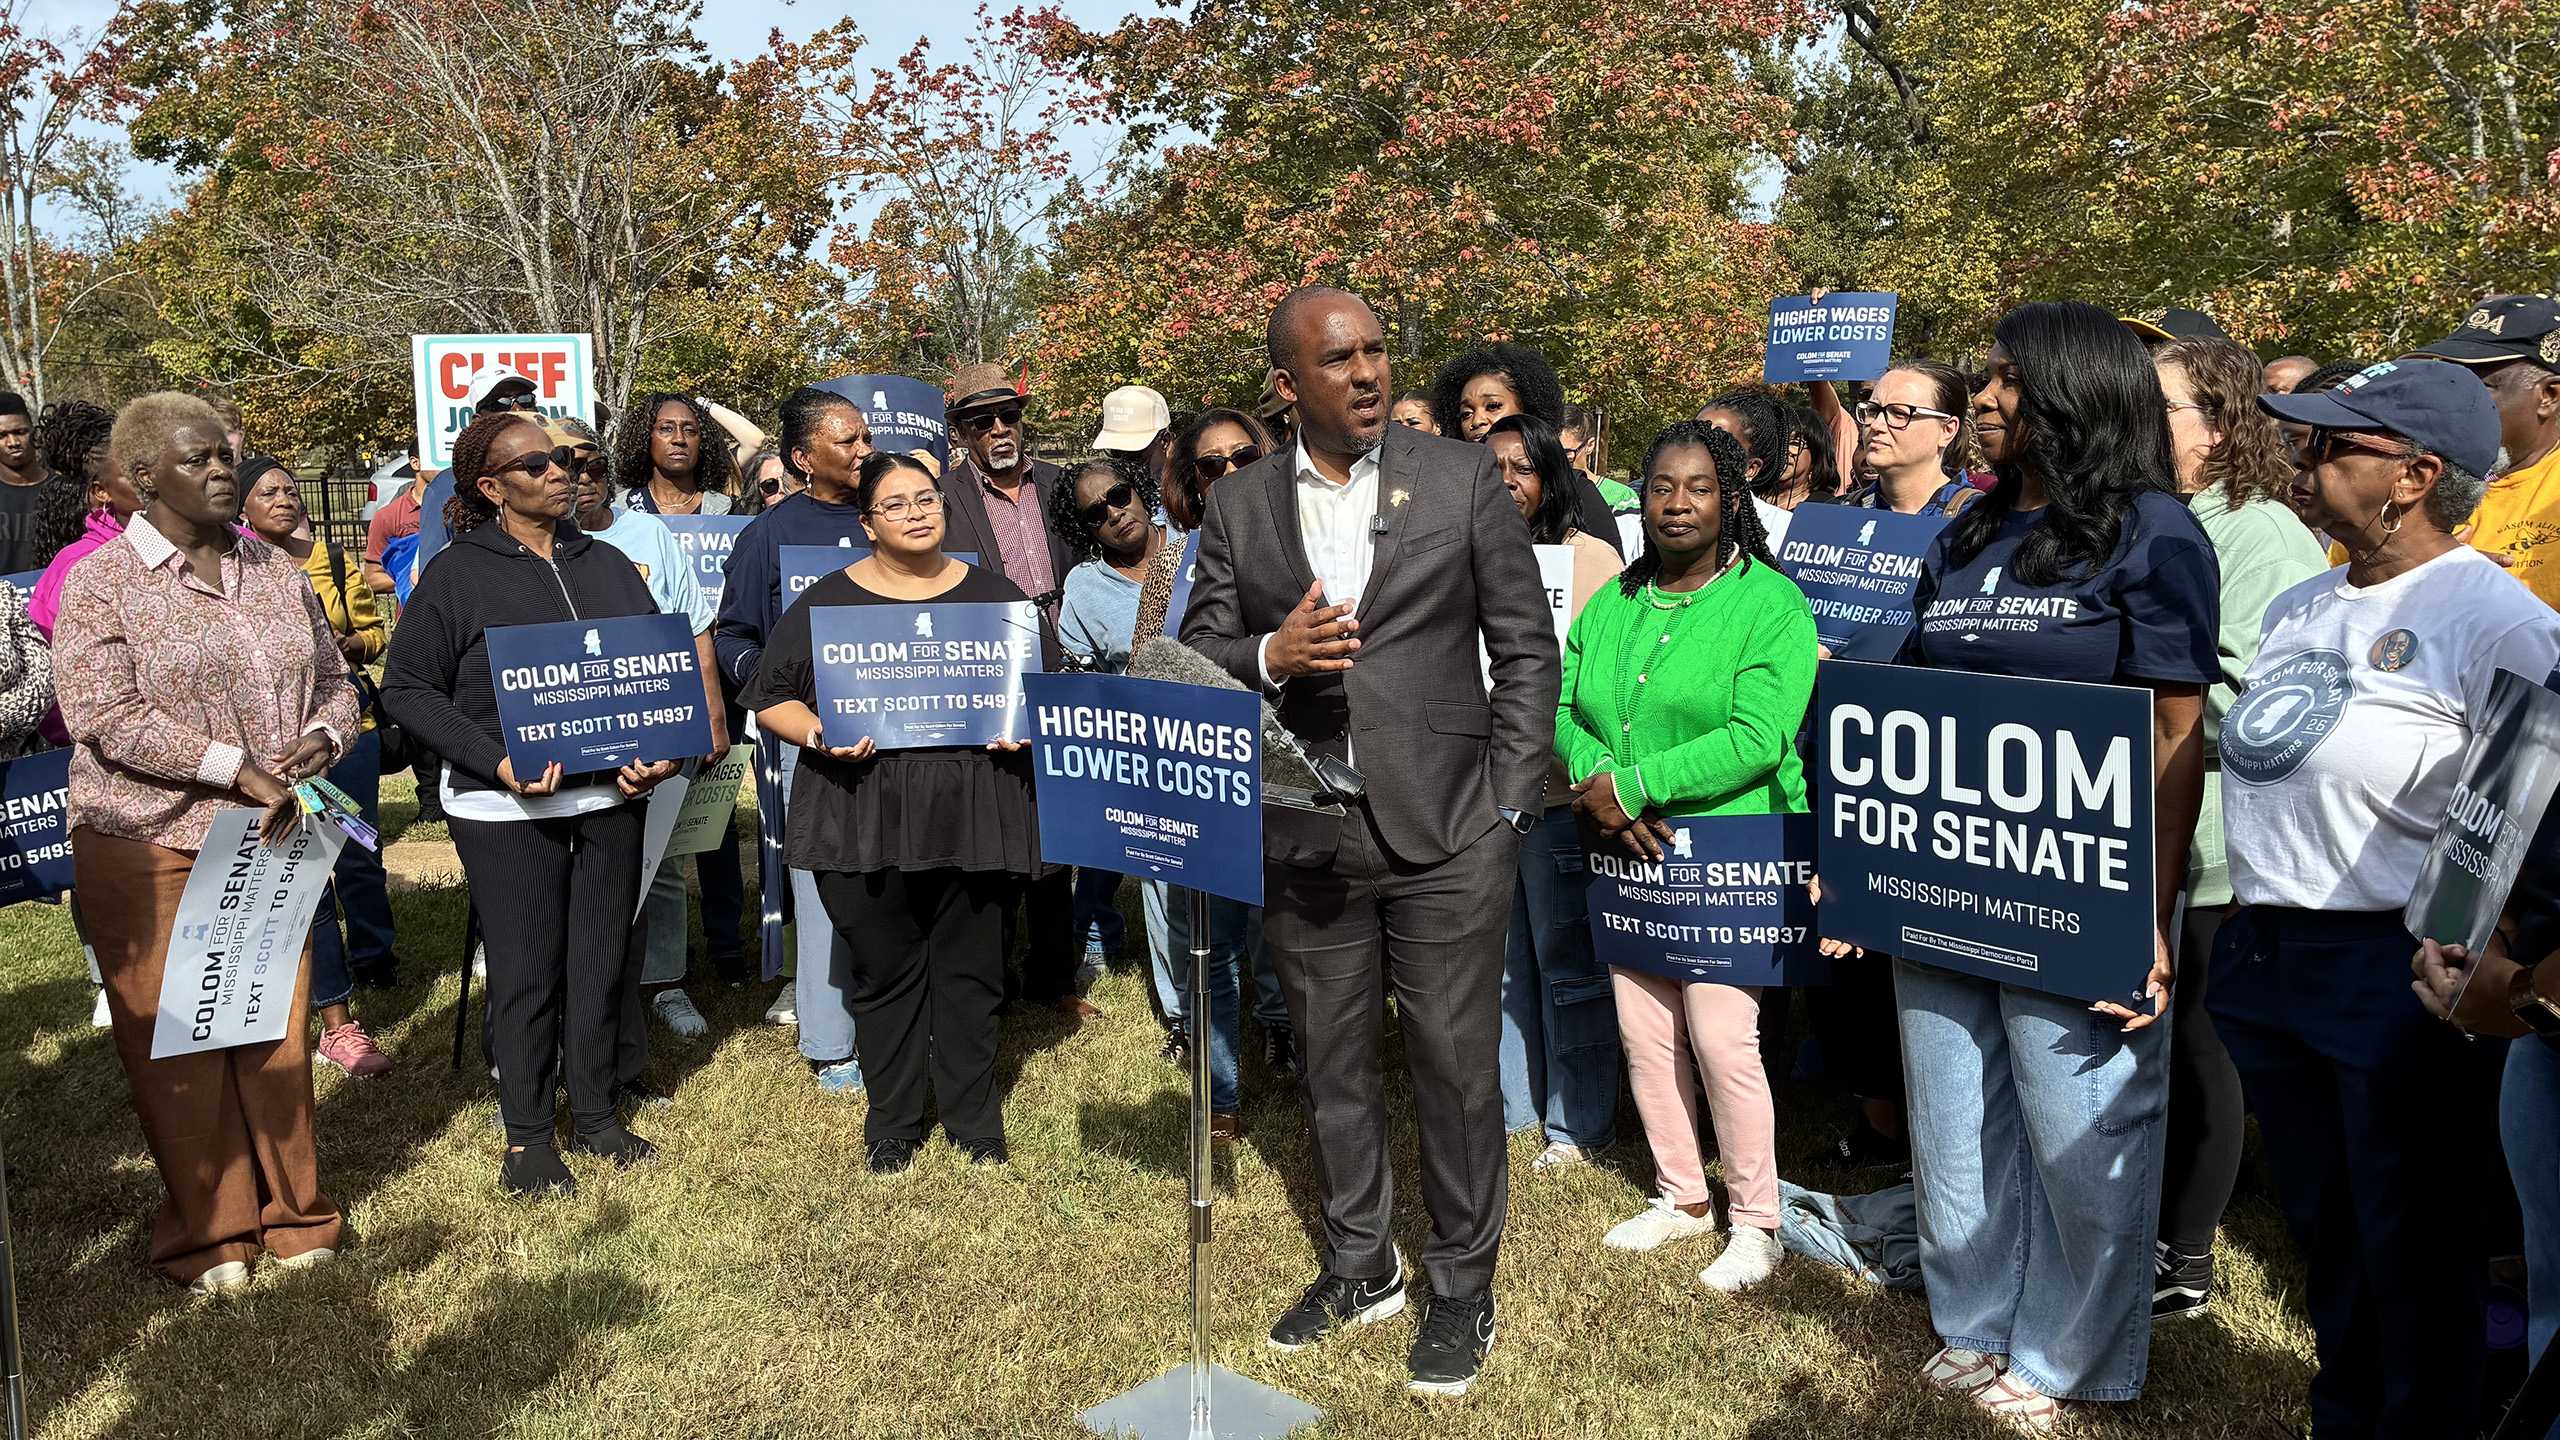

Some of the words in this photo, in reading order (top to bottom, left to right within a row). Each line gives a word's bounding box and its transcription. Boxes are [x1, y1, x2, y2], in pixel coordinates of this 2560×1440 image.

[1774, 307, 1827, 327] HIGHER
[1831, 307, 1890, 322] WAGES
[1772, 326, 1825, 345] LOWER
[1829, 325, 1887, 341] COSTS
[1826, 351, 1851, 359] SENATE
[872, 413, 892, 422] FOR
[896, 411, 945, 436] SENATE
[895, 426, 934, 441] MATTERS
[1783, 541, 1844, 567] COLOM
[1844, 552, 1867, 567] FOR
[1868, 552, 1923, 579] SENA
[1796, 568, 1856, 588] MISSISSIPPI
[1858, 577, 1908, 595] MATTERS
[1882, 609, 1911, 626] 3RD
[1969, 600, 1993, 612] FOR
[1996, 596, 2078, 619] SENATE
[1923, 618, 1980, 633] MISSISSIPPI
[1981, 619, 2039, 632] MATTERS
[823, 642, 908, 664] COLOM
[913, 645, 940, 658] FOR
[944, 639, 1033, 661] SENATE
[501, 663, 580, 691] COLOM
[583, 664, 610, 679] FOR
[613, 651, 694, 679] SENATE
[856, 665, 940, 681] MISSISSIPPI
[944, 664, 1004, 678] MATTERS
[2297, 661, 2327, 675] FOR
[533, 684, 611, 706] MISSISSIPPI
[614, 678, 670, 697] MATTERS
[833, 697, 879, 714] TEXT
[884, 695, 941, 712] SCOTT
[943, 694, 967, 709] TO
[972, 692, 1026, 709] 5497
[517, 723, 556, 743] TEXT
[561, 715, 613, 737] SCOTT
[616, 712, 638, 730] TO
[642, 705, 694, 726] 54937
[1038, 705, 1147, 747] HIGHER
[1152, 716, 1252, 763] WAGES
[2306, 718, 2328, 732] 26
[1829, 703, 2131, 829] COLOM
[2263, 738, 2303, 771] MATTERS
[1044, 744, 1150, 788] LOWER
[1156, 757, 1251, 807] COSTS
[0, 787, 69, 822] ENAT
[695, 784, 737, 805] COSTS
[1105, 807, 1144, 827] COLOM
[1145, 817, 1158, 827] FOR
[1159, 817, 1200, 839] SENATE
[1120, 825, 1158, 840] MISSISSIPPI
[1158, 833, 1186, 847] MATTERS
[0, 854, 22, 871] TO
[26, 840, 74, 865] 5493
[1834, 792, 1918, 853] FOR
[1932, 810, 2129, 891] SENATE
[220, 818, 261, 910] SENATE
[1590, 852, 1665, 886] COLOM
[1670, 868, 1700, 882] FOR
[1706, 861, 1811, 887] SENATE
[1618, 884, 1700, 906] MISSISSIPPI
[1705, 891, 1777, 906] MATTERS
[1867, 872, 1978, 914] MISSISSIPPI
[1985, 896, 2081, 935] MATTERS
[213, 916, 231, 946] FOR
[221, 917, 250, 1005] MISSISSIPPI
[242, 848, 272, 913] MATTERS
[244, 982, 264, 1028] TEXT
[254, 917, 280, 975] SCOTT
[270, 889, 288, 913] TO
[280, 828, 313, 884] 54937
[1602, 912, 1640, 934] TEXT
[1645, 921, 1701, 943] SCOTT
[1707, 927, 1733, 944] TO
[1739, 926, 1807, 944] 54937
[1906, 931, 1918, 940] Paid
[1919, 934, 1928, 942] For
[1929, 936, 1937, 945] By
[1937, 938, 1948, 947] The
[1948, 940, 1981, 954] Mississippi
[1981, 948, 2016, 962] Democratic
[2016, 956, 2034, 967] Party
[192, 951, 225, 1042] COLOM
